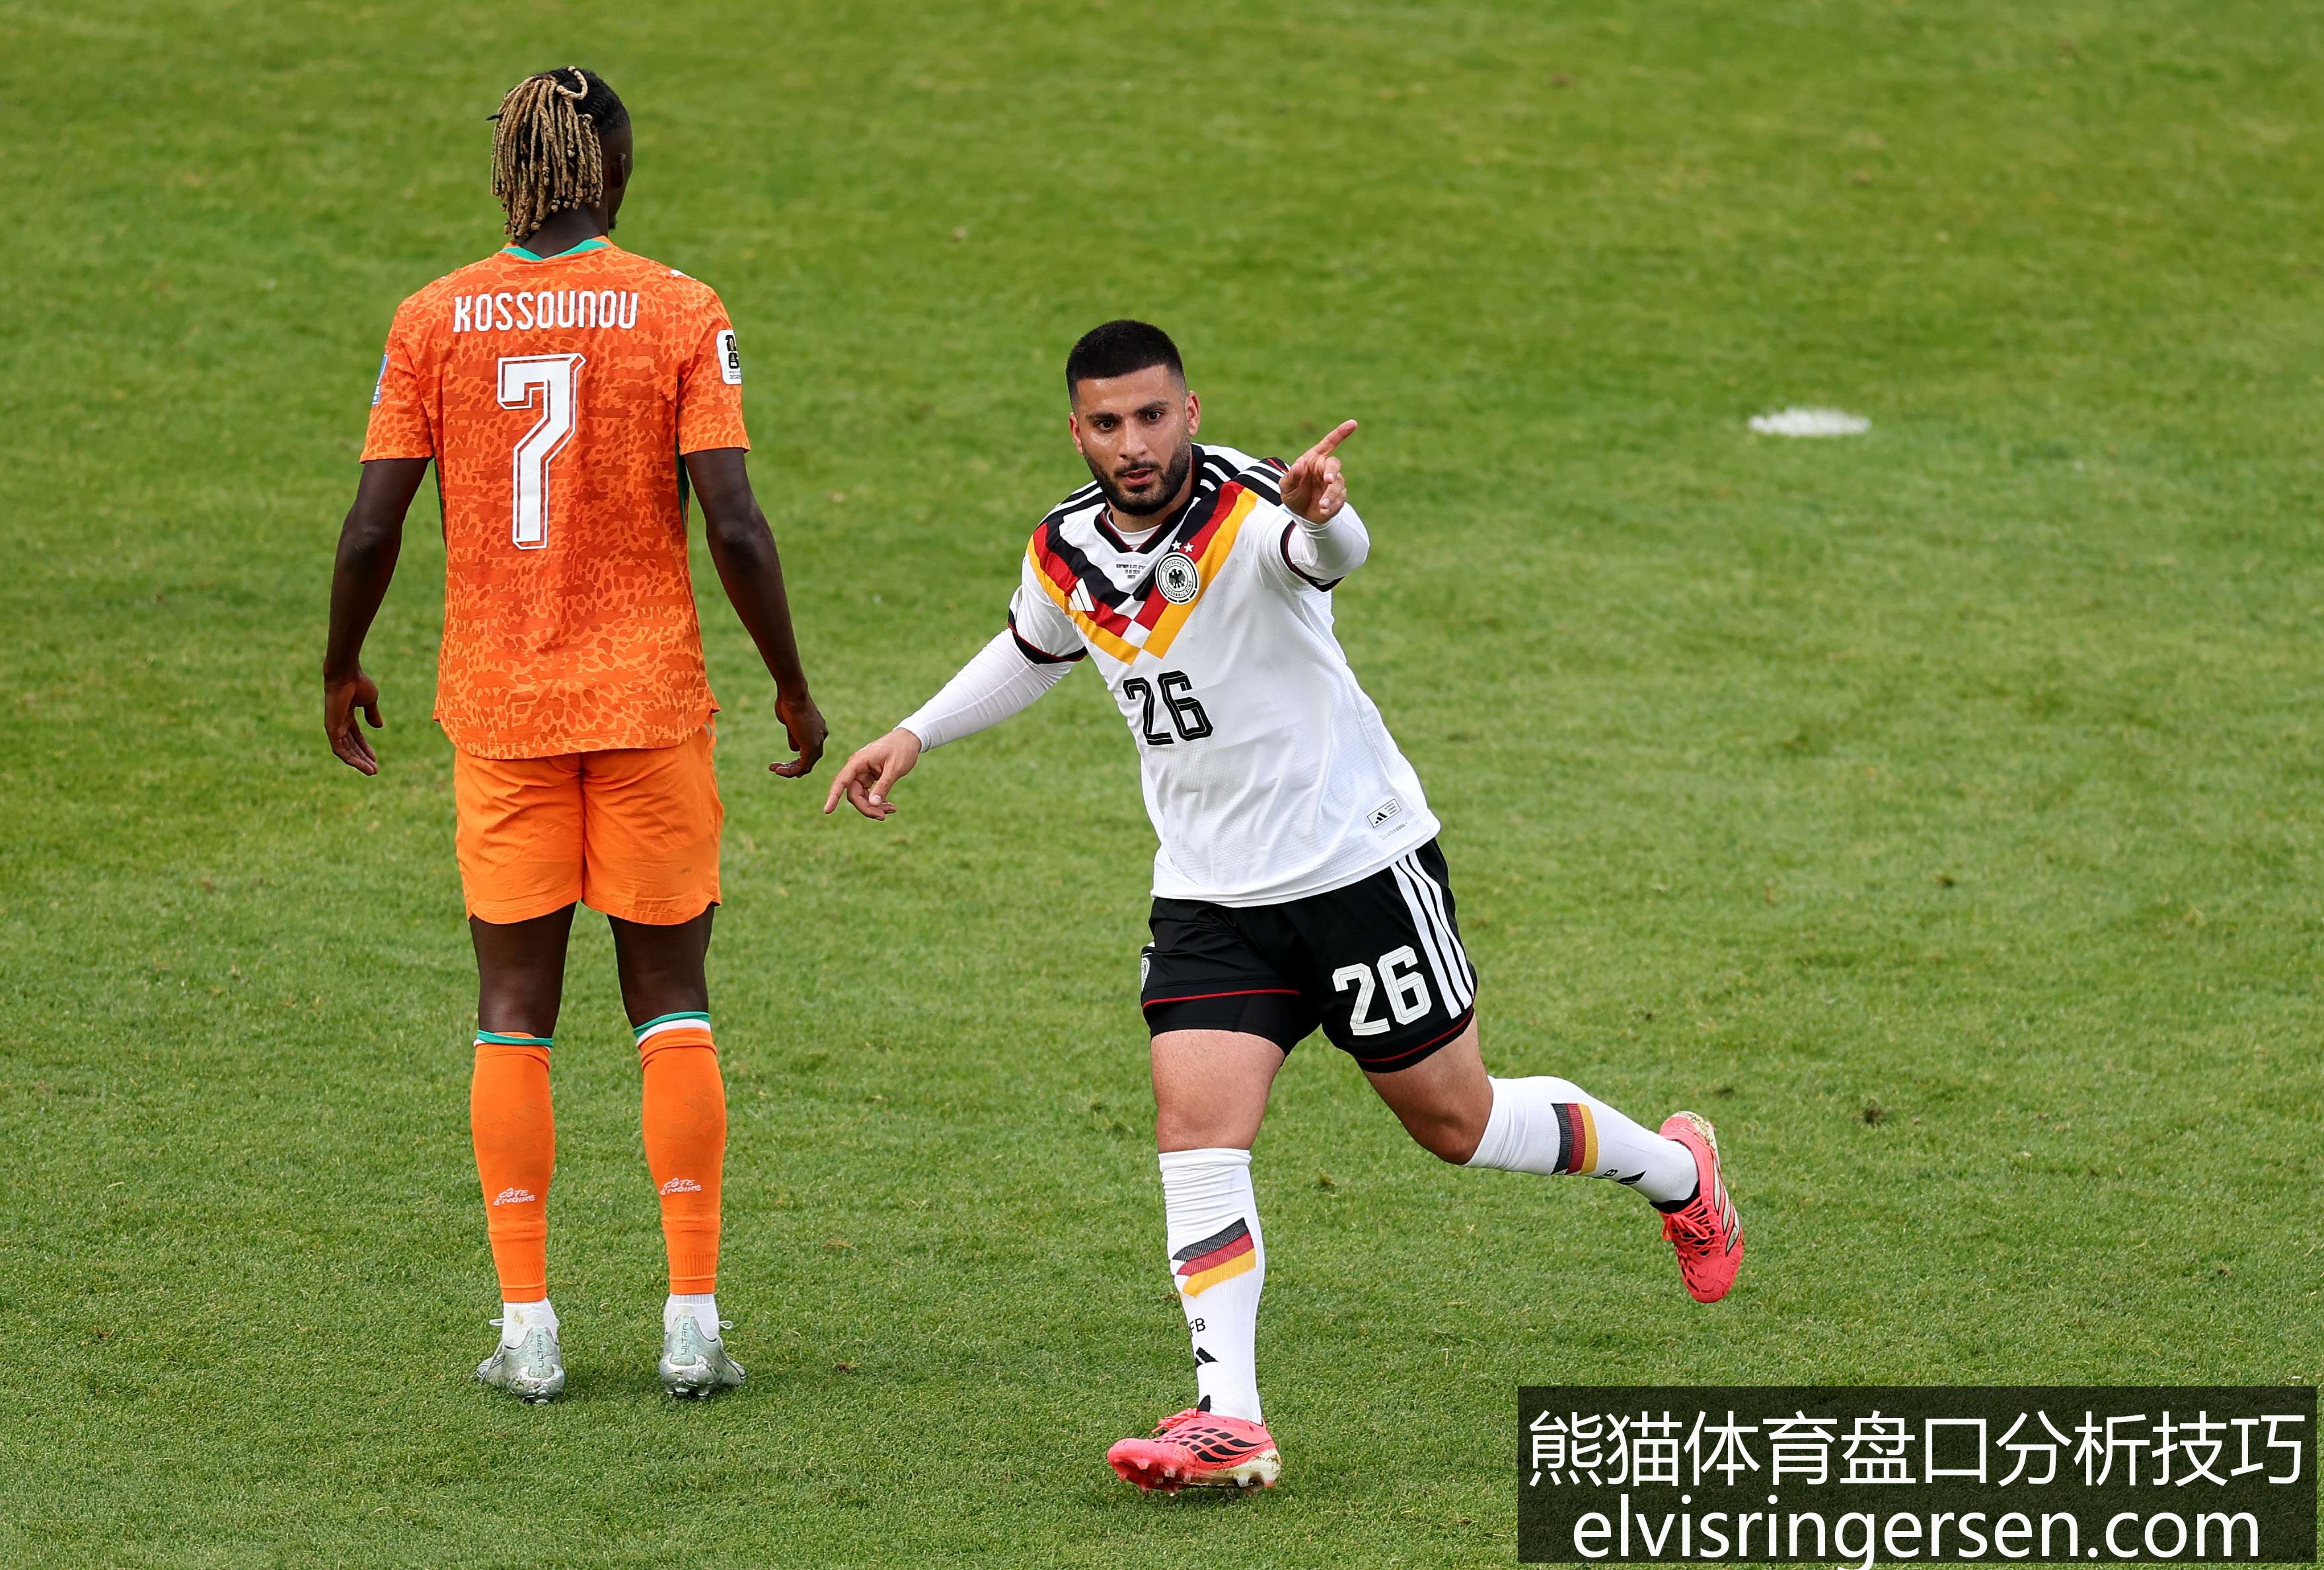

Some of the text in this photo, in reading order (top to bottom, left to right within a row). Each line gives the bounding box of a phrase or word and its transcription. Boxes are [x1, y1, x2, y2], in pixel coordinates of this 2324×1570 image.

[453, 290, 640, 332] KOSSOUNOU
[497, 352, 587, 550] 7
[1123, 670, 1214, 746] 26
[1332, 945, 1433, 1036] 26
